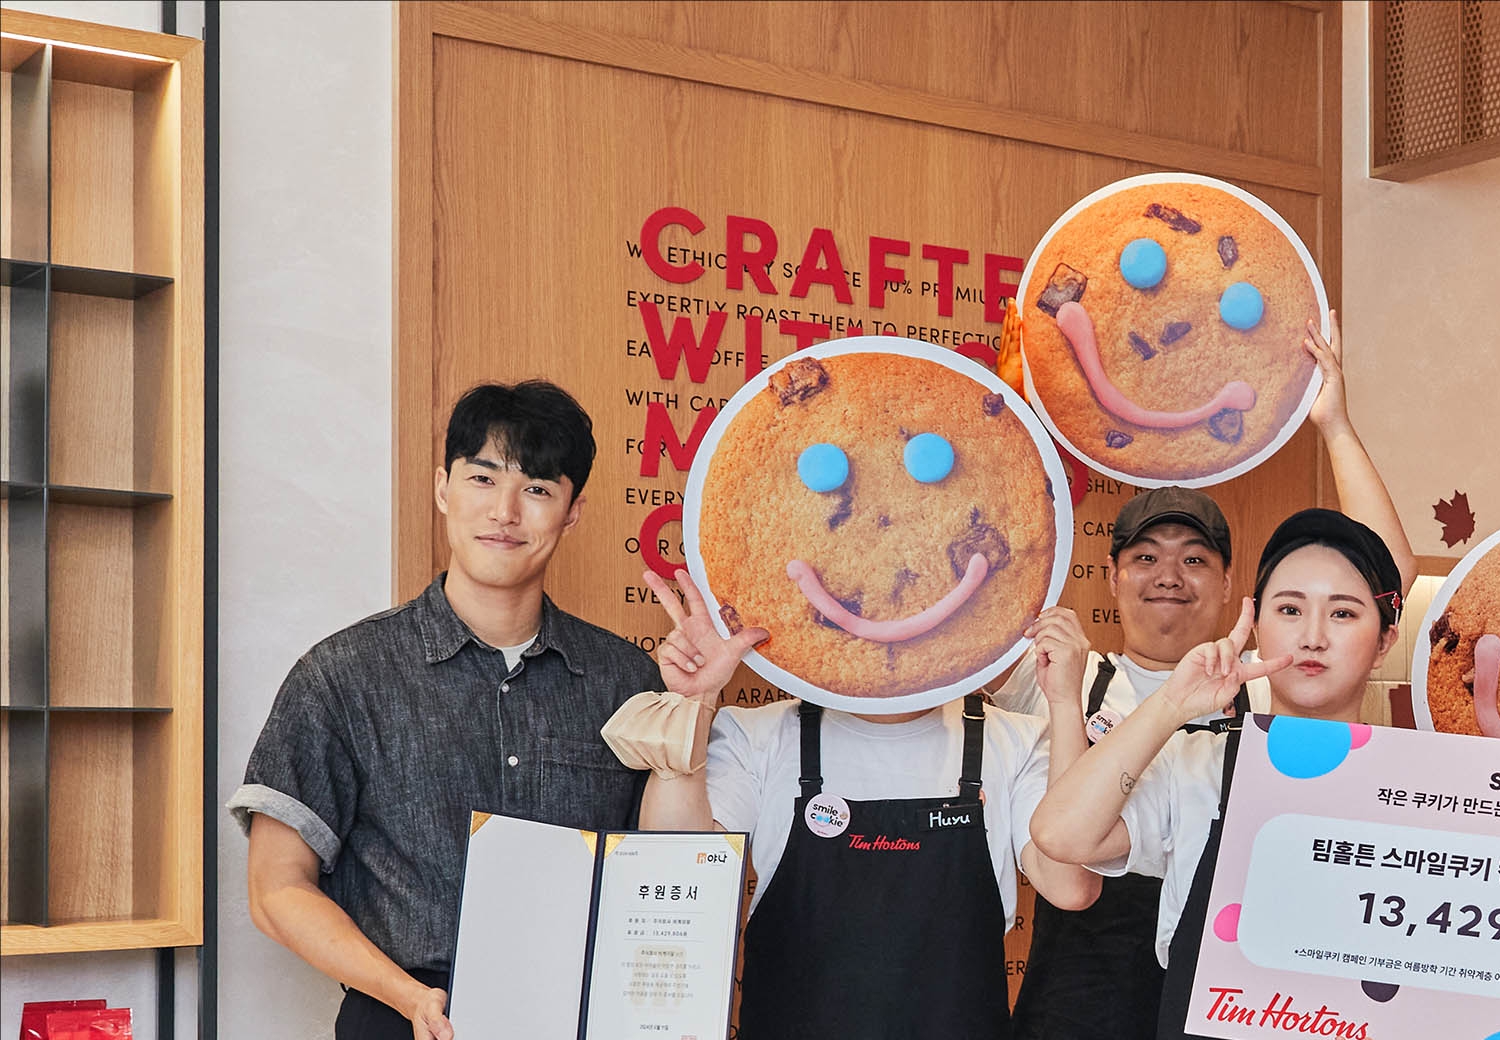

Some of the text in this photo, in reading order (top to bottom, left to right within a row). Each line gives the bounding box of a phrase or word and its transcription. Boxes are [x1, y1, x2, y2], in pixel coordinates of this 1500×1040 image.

[640, 206, 1024, 323] CRAFTE
[737, 304, 801, 323] ROAST
[809, 313, 863, 332] THEM
[872, 321, 897, 335] TO
[907, 325, 1001, 350] PERFECTIO
[639, 301, 898, 383] WIT
[625, 389, 729, 412] WITH CAR
[625, 538, 669, 555] OR
[1072, 564, 1094, 579] OF
[1092, 609, 1121, 624] EVE
[1095, 713, 1114, 729] smile
[813, 802, 838, 817] smile
[1377, 788, 1409, 806] 작은
[1411, 792, 1460, 814] 쿠키가
[849, 834, 921, 851] Tim Hortons
[707, 853, 728, 864] 야나
[1312, 838, 1377, 868] 팀홀튼
[1380, 846, 1493, 882] 스마일쿠키
[1342, 953, 1367, 966] 캠페인
[1368, 957, 1402, 970] 기부금은
[1403, 961, 1438, 975] 여름방학
[1439, 966, 1457, 977] 기간
[1458, 968, 1493, 982] 취약계층
[1206, 987, 1369, 1040] Tim Hortons
